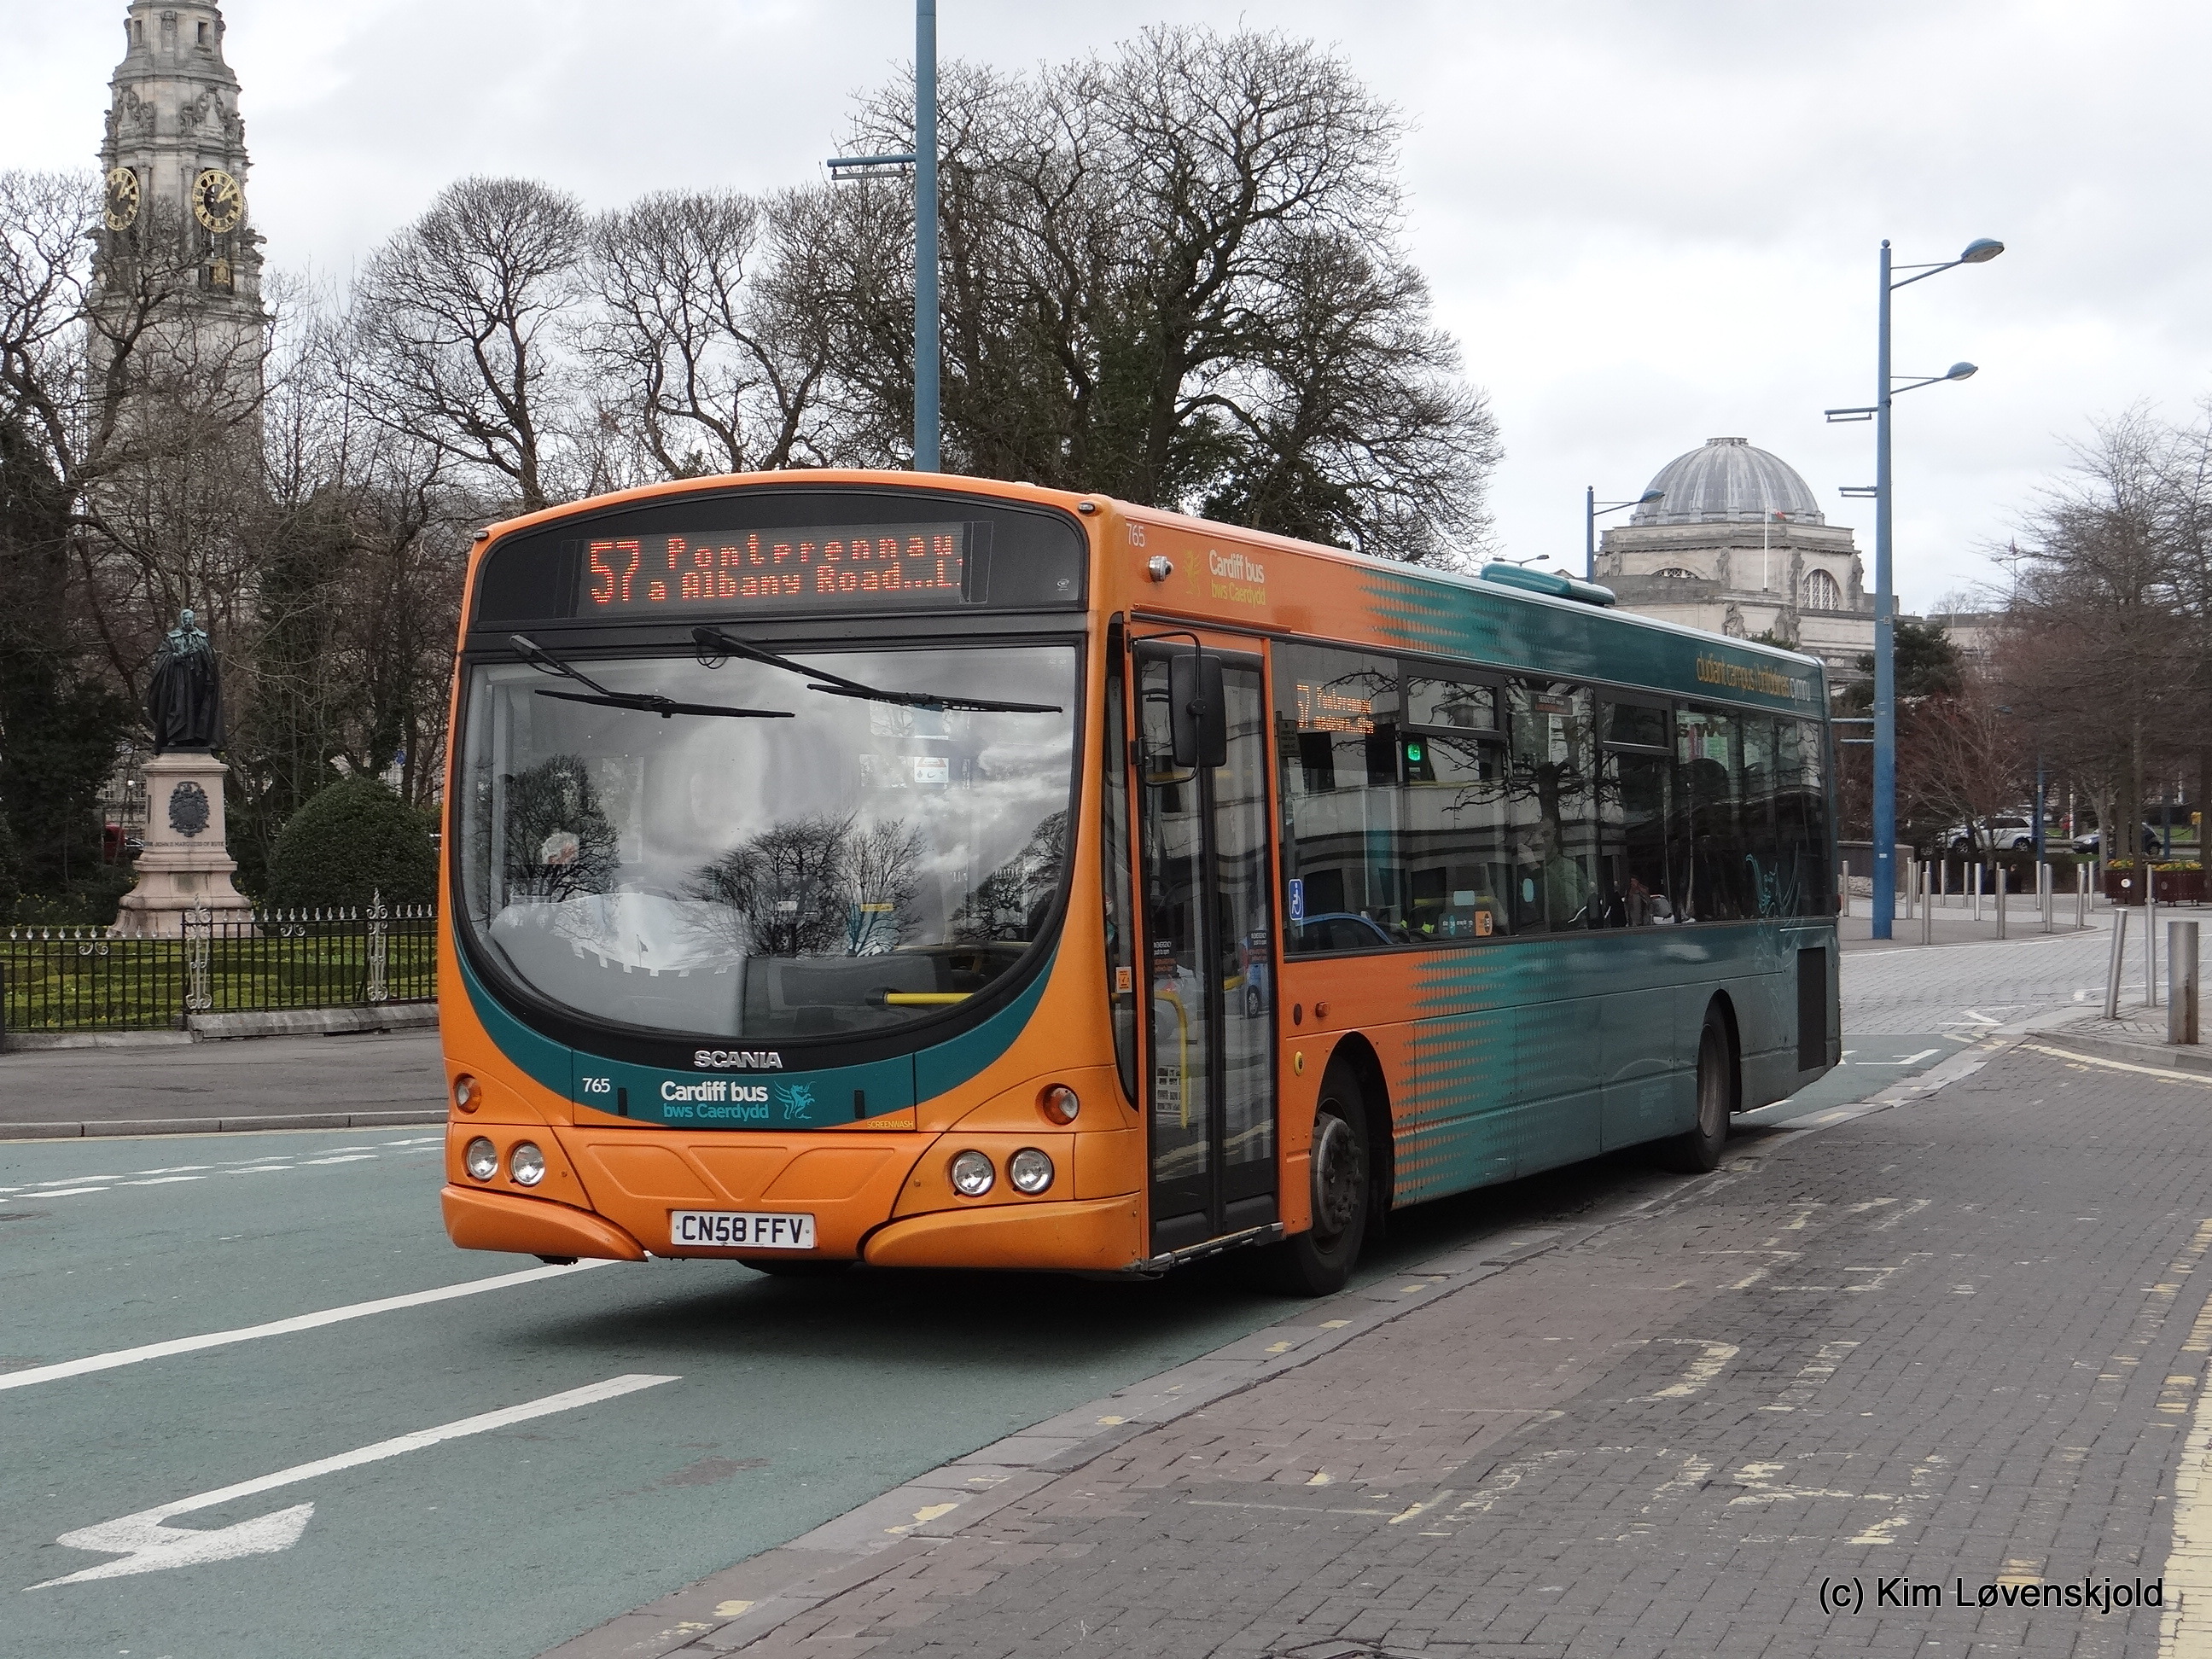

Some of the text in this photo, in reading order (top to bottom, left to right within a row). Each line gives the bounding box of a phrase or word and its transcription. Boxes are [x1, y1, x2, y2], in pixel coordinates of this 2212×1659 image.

[1126, 522, 1145, 548] 765
[590, 539, 640, 603] 57
[1208, 549, 1265, 585] Cardiff bus
[648, 580, 666, 601] a
[682, 570, 800, 599] Albany
[693, 1050, 783, 1069] SCANIA
[582, 1077, 611, 1094] 765
[661, 1080, 768, 1103] Cardiff bus
[663, 1103, 769, 1122] bws Caerdydd
[867, 1120, 914, 1128] SCREENWASH
[682, 1215, 803, 1243] CN58 FFV
